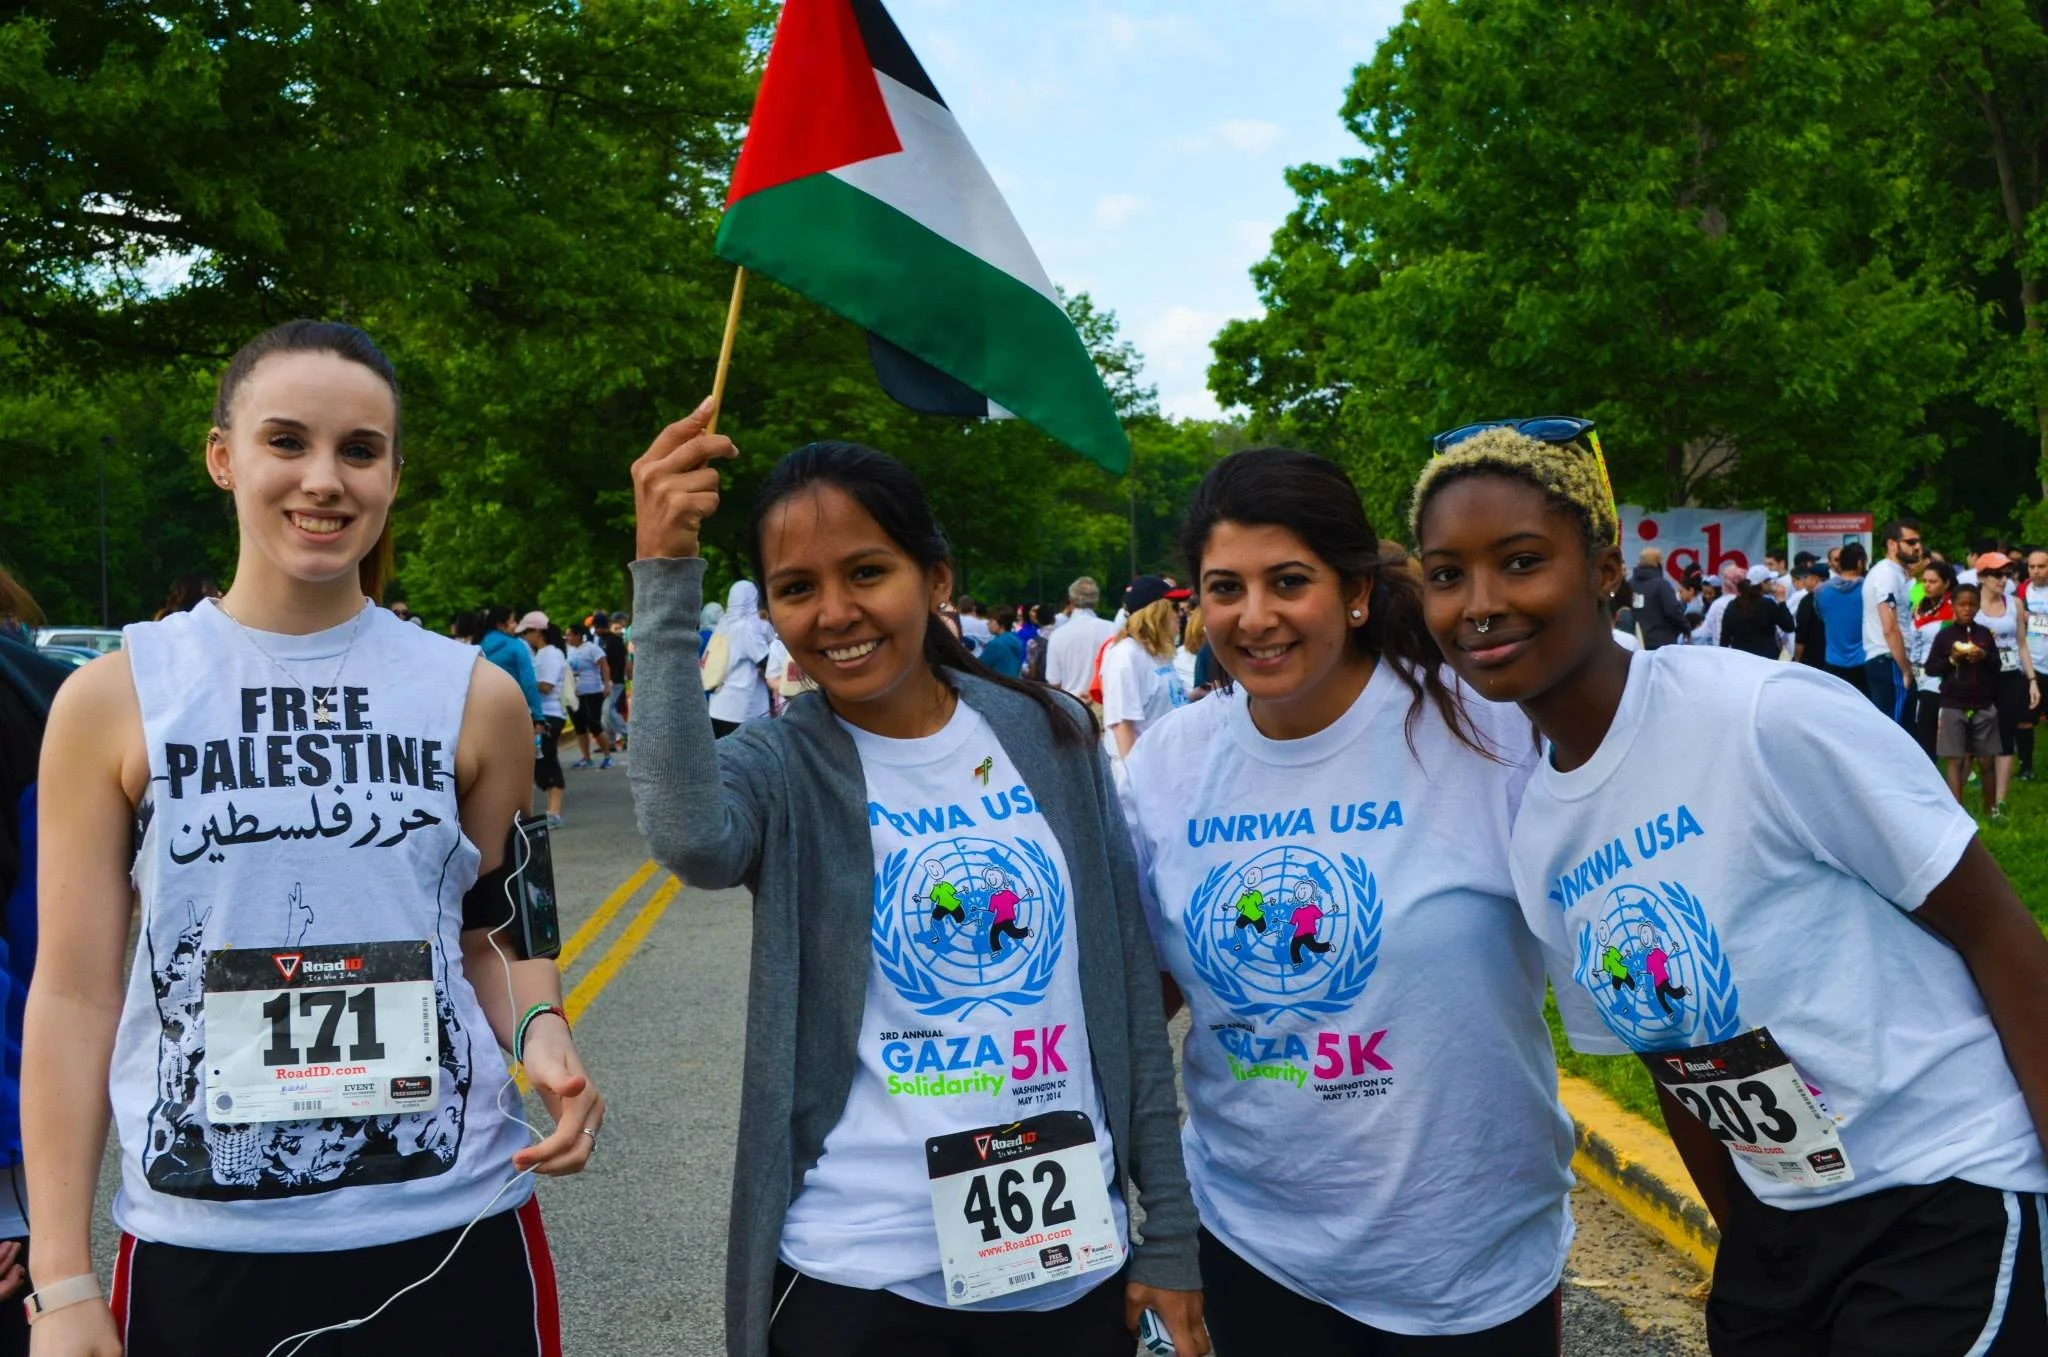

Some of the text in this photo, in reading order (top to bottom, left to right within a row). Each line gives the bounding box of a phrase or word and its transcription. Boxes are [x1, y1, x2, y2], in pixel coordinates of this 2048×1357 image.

[241, 686, 372, 733] FREE
[165, 733, 444, 799] PALESTINE
[170, 784, 352, 865] فلسطين
[868, 784, 1041, 836] NRWA US
[1187, 800, 1404, 848] UNRWA USA
[1634, 804, 1704, 859] USA
[302, 957, 363, 973] RoadID
[263, 987, 385, 1066] 171
[880, 1029, 944, 1041] 3RD ANNUAL
[881, 1024, 1069, 1081] GAZA 5K
[1216, 1029, 1394, 1080] GAZA 5K
[276, 1066, 367, 1080] RoadID.com
[344, 1083, 375, 1092] EVENT
[887, 1071, 1005, 1097] Solidarity
[1011, 1079, 1067, 1096] WASHINGTON DC
[1314, 1077, 1394, 1093] WASHINGTON DC
[1017, 1096, 1033, 1106] MAY
[1322, 1087, 1387, 1101] MAY 17, 2014
[1675, 1080, 1797, 1144] 203
[991, 1131, 1037, 1150] RoadID
[963, 1160, 1076, 1242] 462
[978, 1228, 1073, 1260] www.RoadID.com
